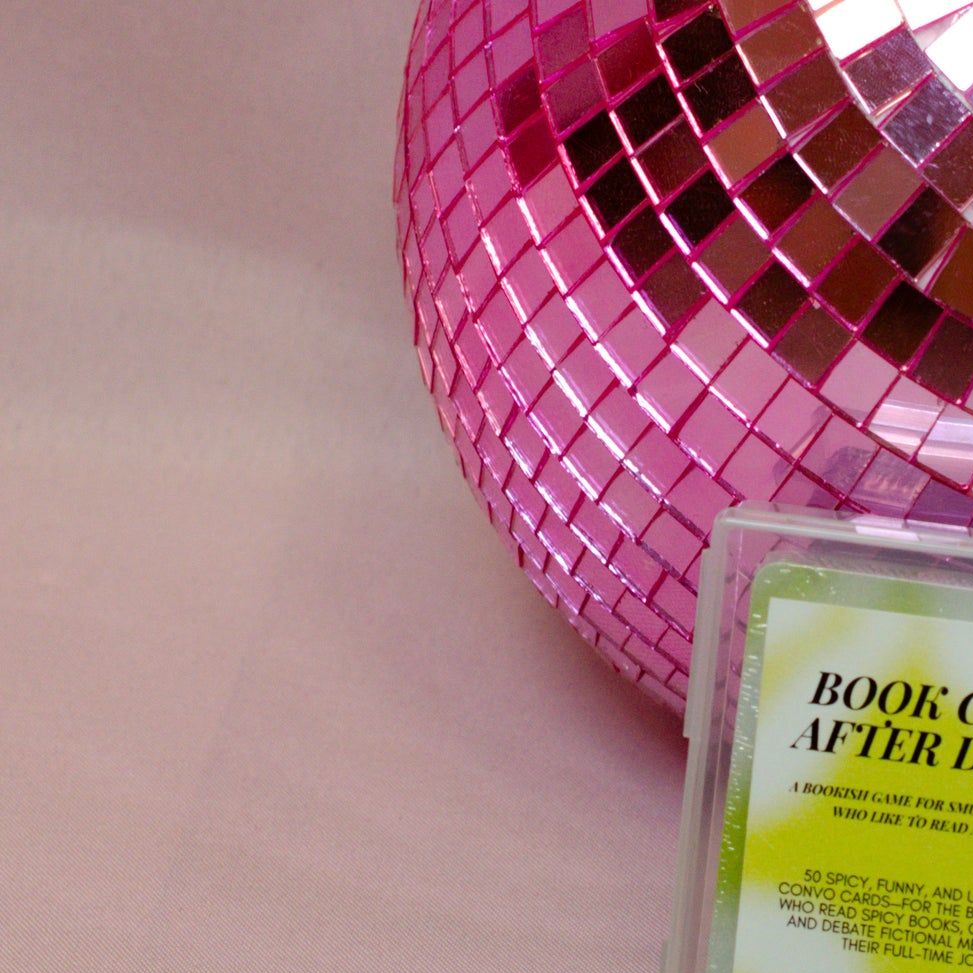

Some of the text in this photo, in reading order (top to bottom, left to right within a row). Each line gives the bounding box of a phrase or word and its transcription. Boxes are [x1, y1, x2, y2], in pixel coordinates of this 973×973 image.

[808, 671, 948, 721] BOOK
[790, 717, 942, 767] AFTER
[789, 782, 799, 792] A
[803, 783, 869, 801] BOOKISH
[872, 792, 914, 807] GAME
[916, 797, 944, 812] FOR
[833, 806, 868, 821] WHO
[870, 811, 904, 826] LIKE
[907, 815, 927, 829] TO
[930, 819, 968, 834] READ
[778, 881, 836, 900] CONVO
[936, 902, 961, 918] THE
[804, 869, 822, 884] 50
[826, 872, 872, 891] SPICY,
[877, 878, 928, 898] FUNNY,
[932, 887, 963, 901] AND
[779, 898, 814, 913] WHO
[819, 903, 857, 919] READ
[862, 908, 904, 924] SPICY
[909, 914, 963, 935] BOOKS,
[786, 915, 817, 930] AND
[822, 919, 875, 938] DEBATE
[880, 926, 953, 948] FICTIONAL
[842, 937, 880, 954] THEIR
[884, 943, 954, 964] FULL-TIME
